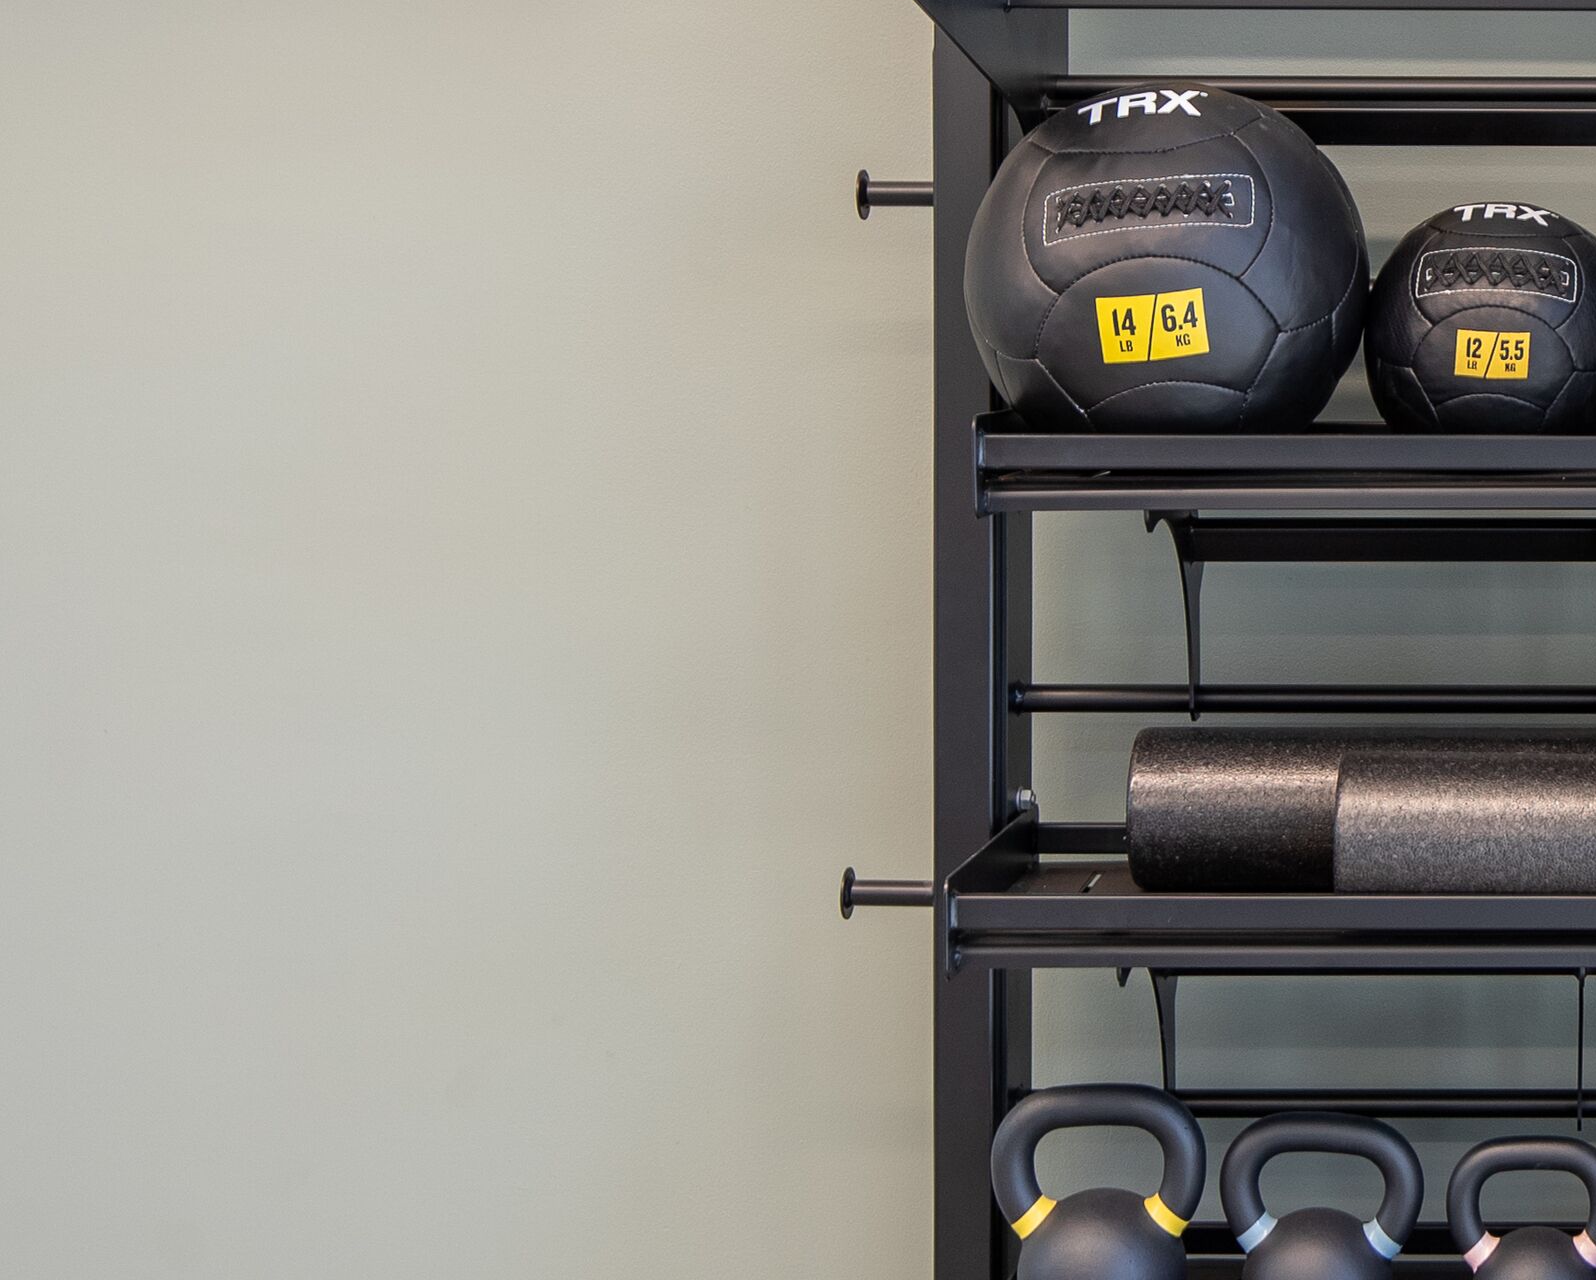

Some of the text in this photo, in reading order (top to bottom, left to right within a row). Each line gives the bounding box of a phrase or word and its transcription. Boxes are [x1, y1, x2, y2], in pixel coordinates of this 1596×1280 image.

[1078, 89, 1203, 125] TRX
[1453, 203, 1551, 227] TRX
[1112, 301, 1198, 336] 14 6.4
[1119, 333, 1191, 352] LB KG
[1466, 337, 1524, 360] 12 5.5
[1467, 360, 1516, 372] LB KG
